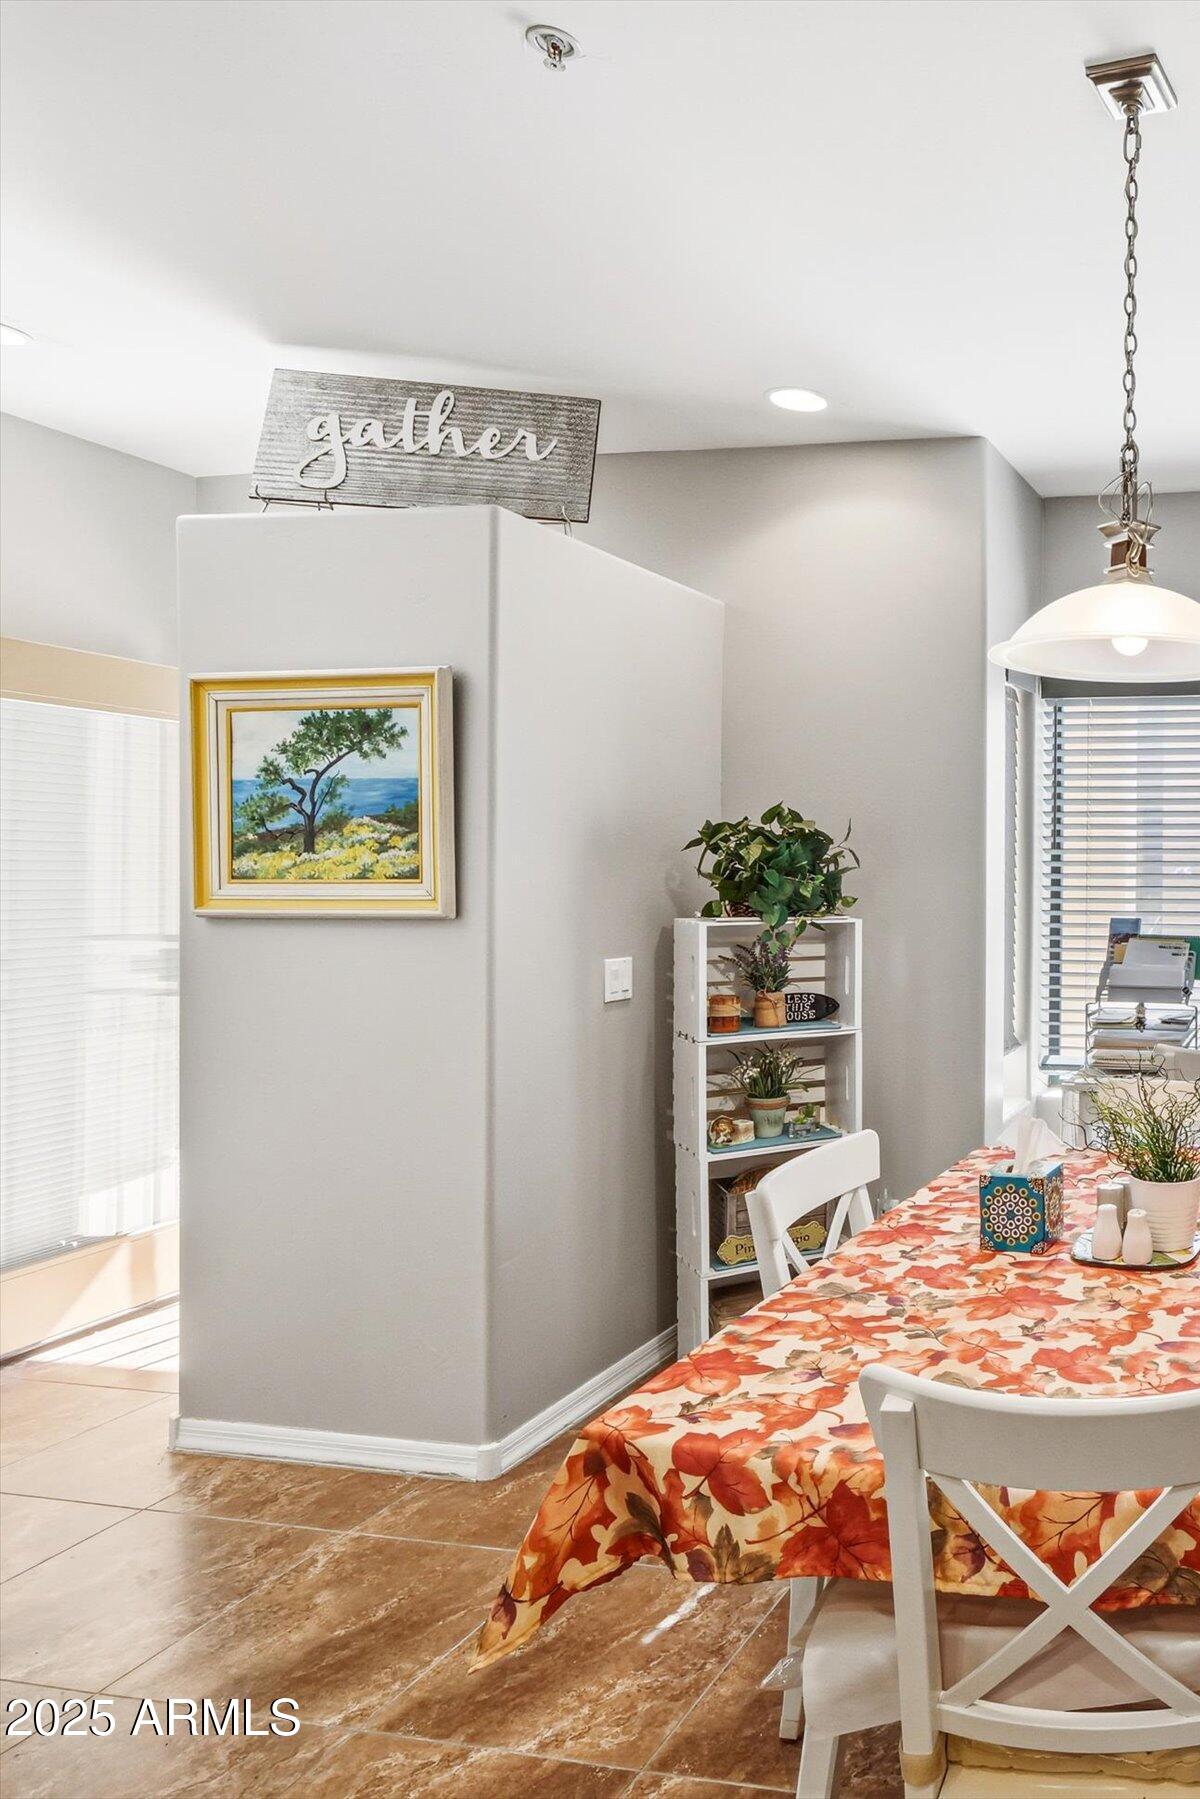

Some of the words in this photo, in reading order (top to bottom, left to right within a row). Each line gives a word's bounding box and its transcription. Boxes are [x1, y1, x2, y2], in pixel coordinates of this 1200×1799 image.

[294, 390, 558, 489] gather
[787, 994, 816, 1003] LESS
[786, 1010, 816, 1020] OUSE
[735, 1243, 756, 1255] Pin
